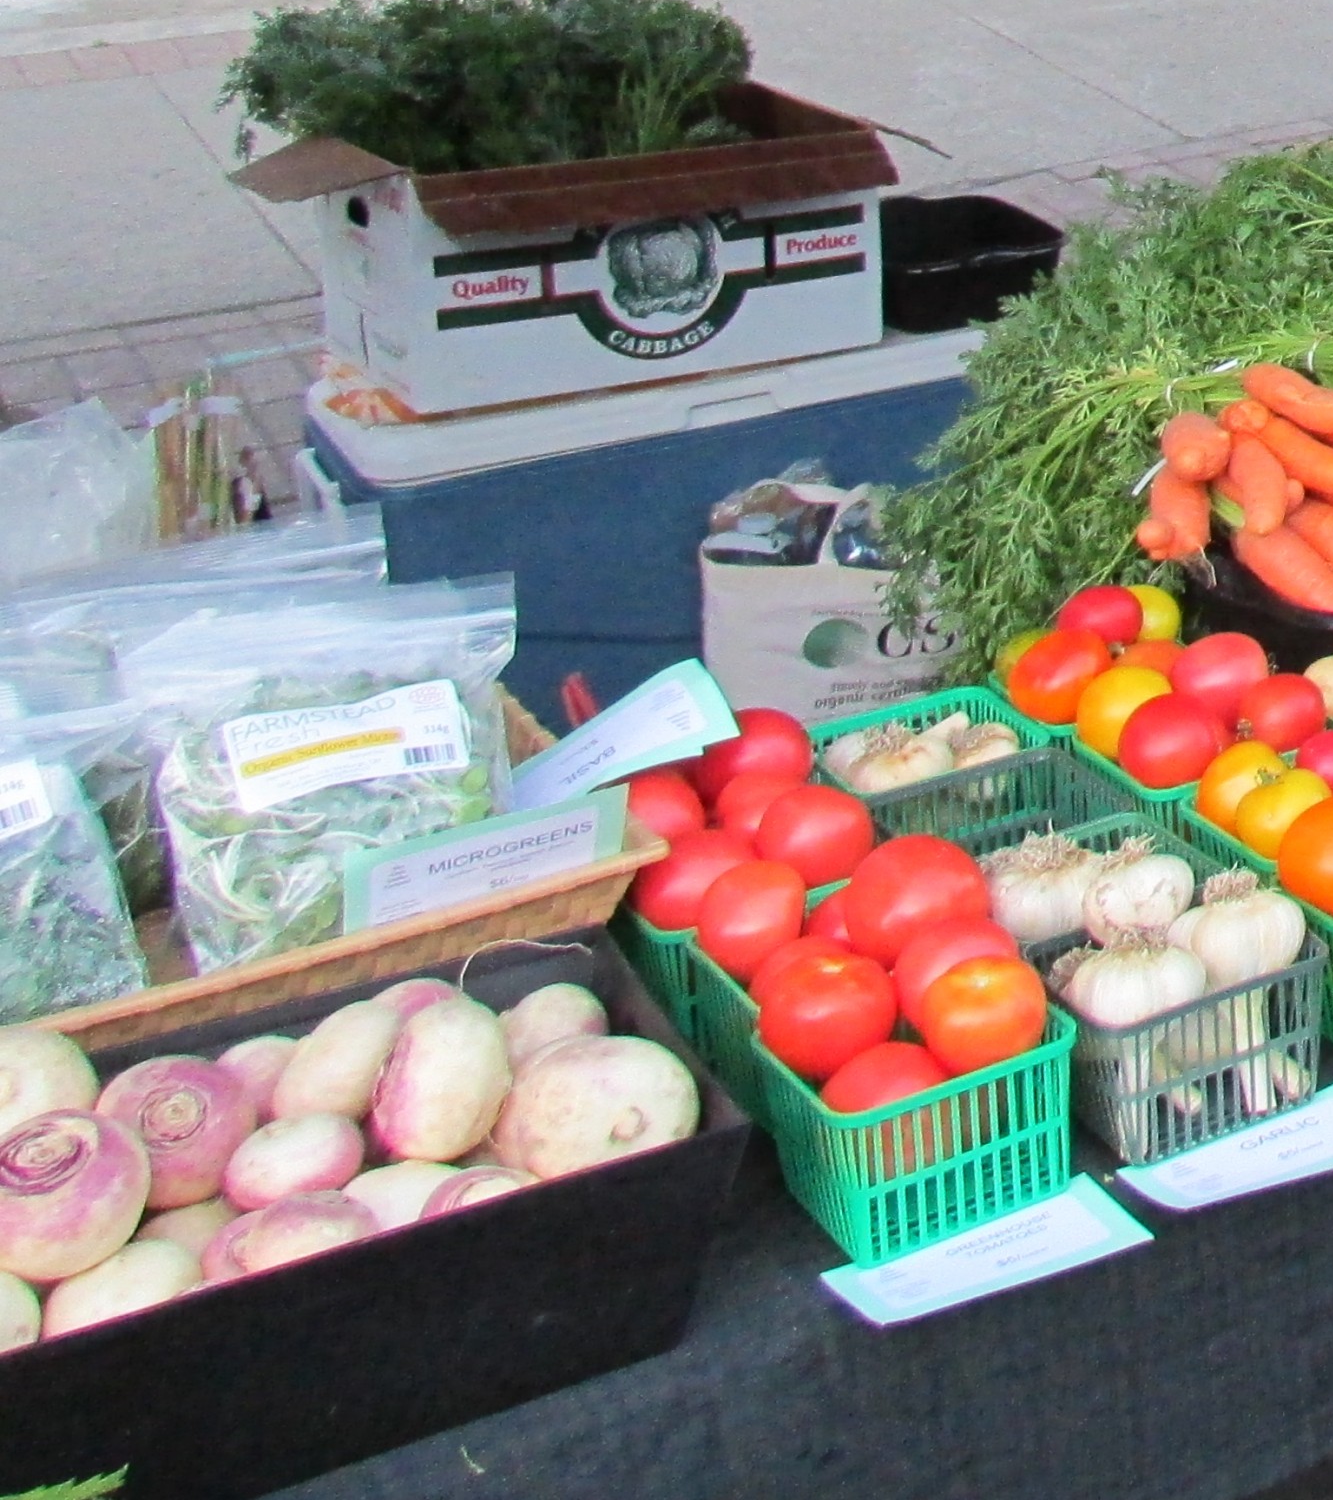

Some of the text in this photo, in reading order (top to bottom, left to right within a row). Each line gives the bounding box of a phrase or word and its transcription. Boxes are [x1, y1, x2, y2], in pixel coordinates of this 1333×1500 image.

[452, 232, 858, 301] Quality Produce
[607, 321, 716, 356] CABBAGE
[229, 695, 397, 744] FARMSTEAD
[234, 726, 321, 757] Fresh
[296, 737, 359, 761] Sunflower
[559, 745, 617, 786] BASIL
[428, 820, 593, 876] MICROGREENS
[1239, 1115, 1320, 1152] GARLIC
[944, 1210, 1052, 1258] GREENHOUSE
[965, 1224, 1049, 1260] TOMATOES
